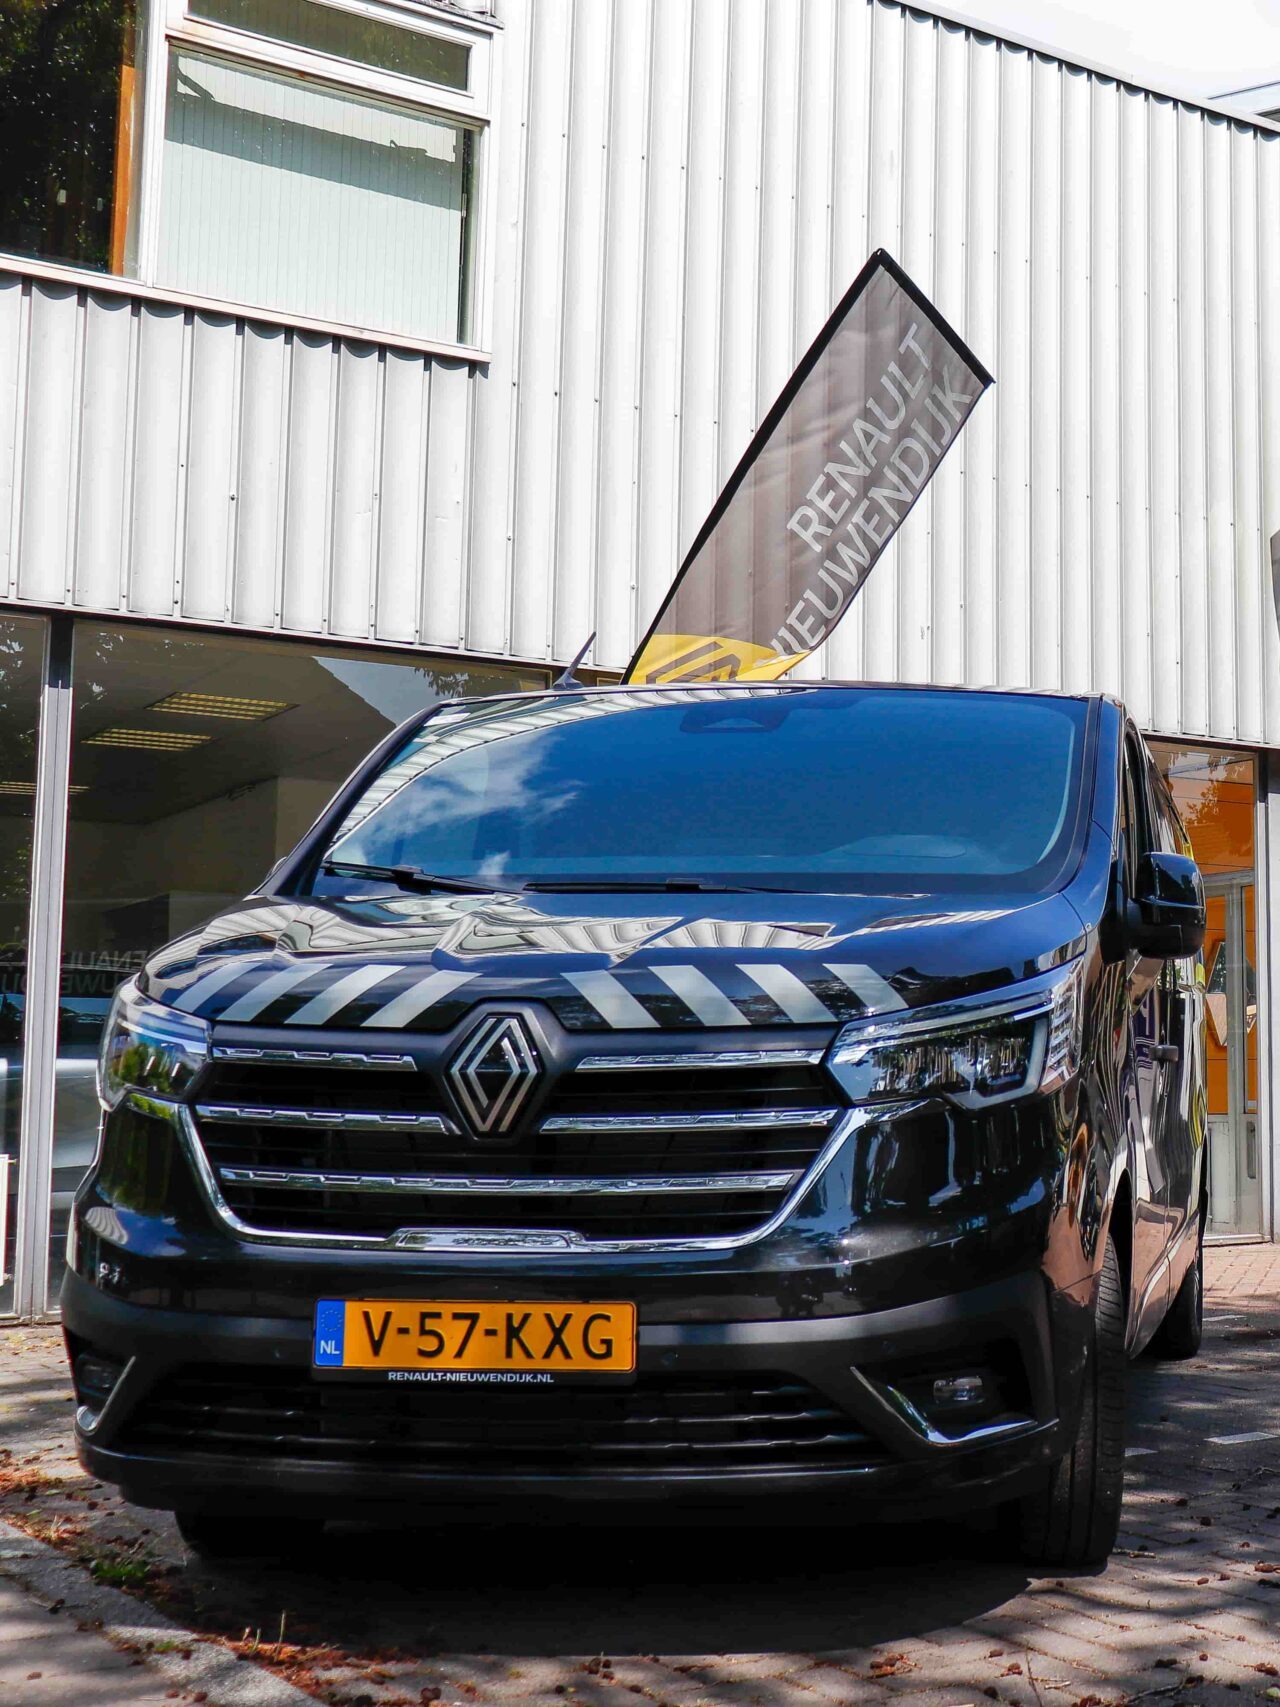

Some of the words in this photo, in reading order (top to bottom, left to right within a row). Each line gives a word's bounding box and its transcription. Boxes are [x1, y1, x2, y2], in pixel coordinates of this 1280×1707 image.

[786, 322, 932, 553] RENAULT
[319, 1340, 341, 1354] NL
[362, 1310, 614, 1360] V-57-KXG
[388, 1371, 554, 1383] RENAULT-NIEUWENDIJK.NL
